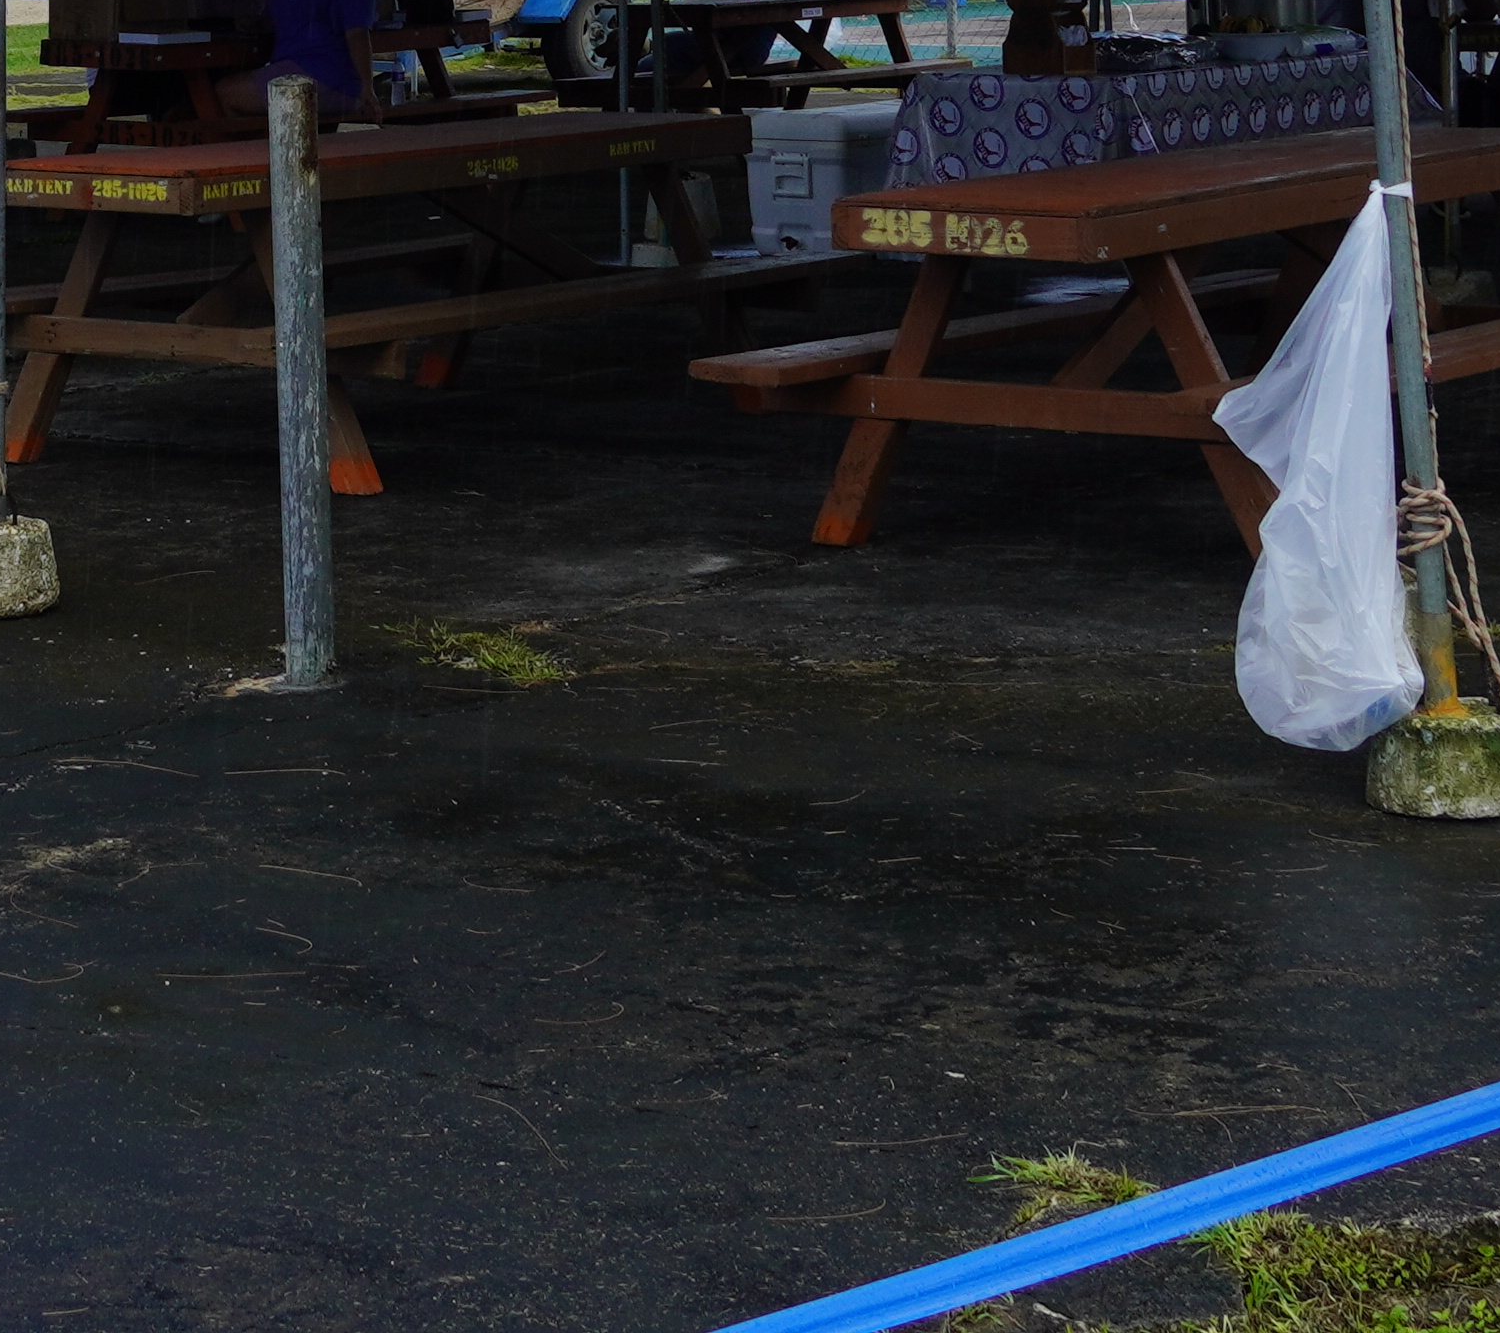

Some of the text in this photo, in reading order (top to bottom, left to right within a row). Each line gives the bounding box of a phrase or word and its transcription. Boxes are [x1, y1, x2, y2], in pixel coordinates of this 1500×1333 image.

[36, 179, 262, 201] TENT 285-1026 TENT
